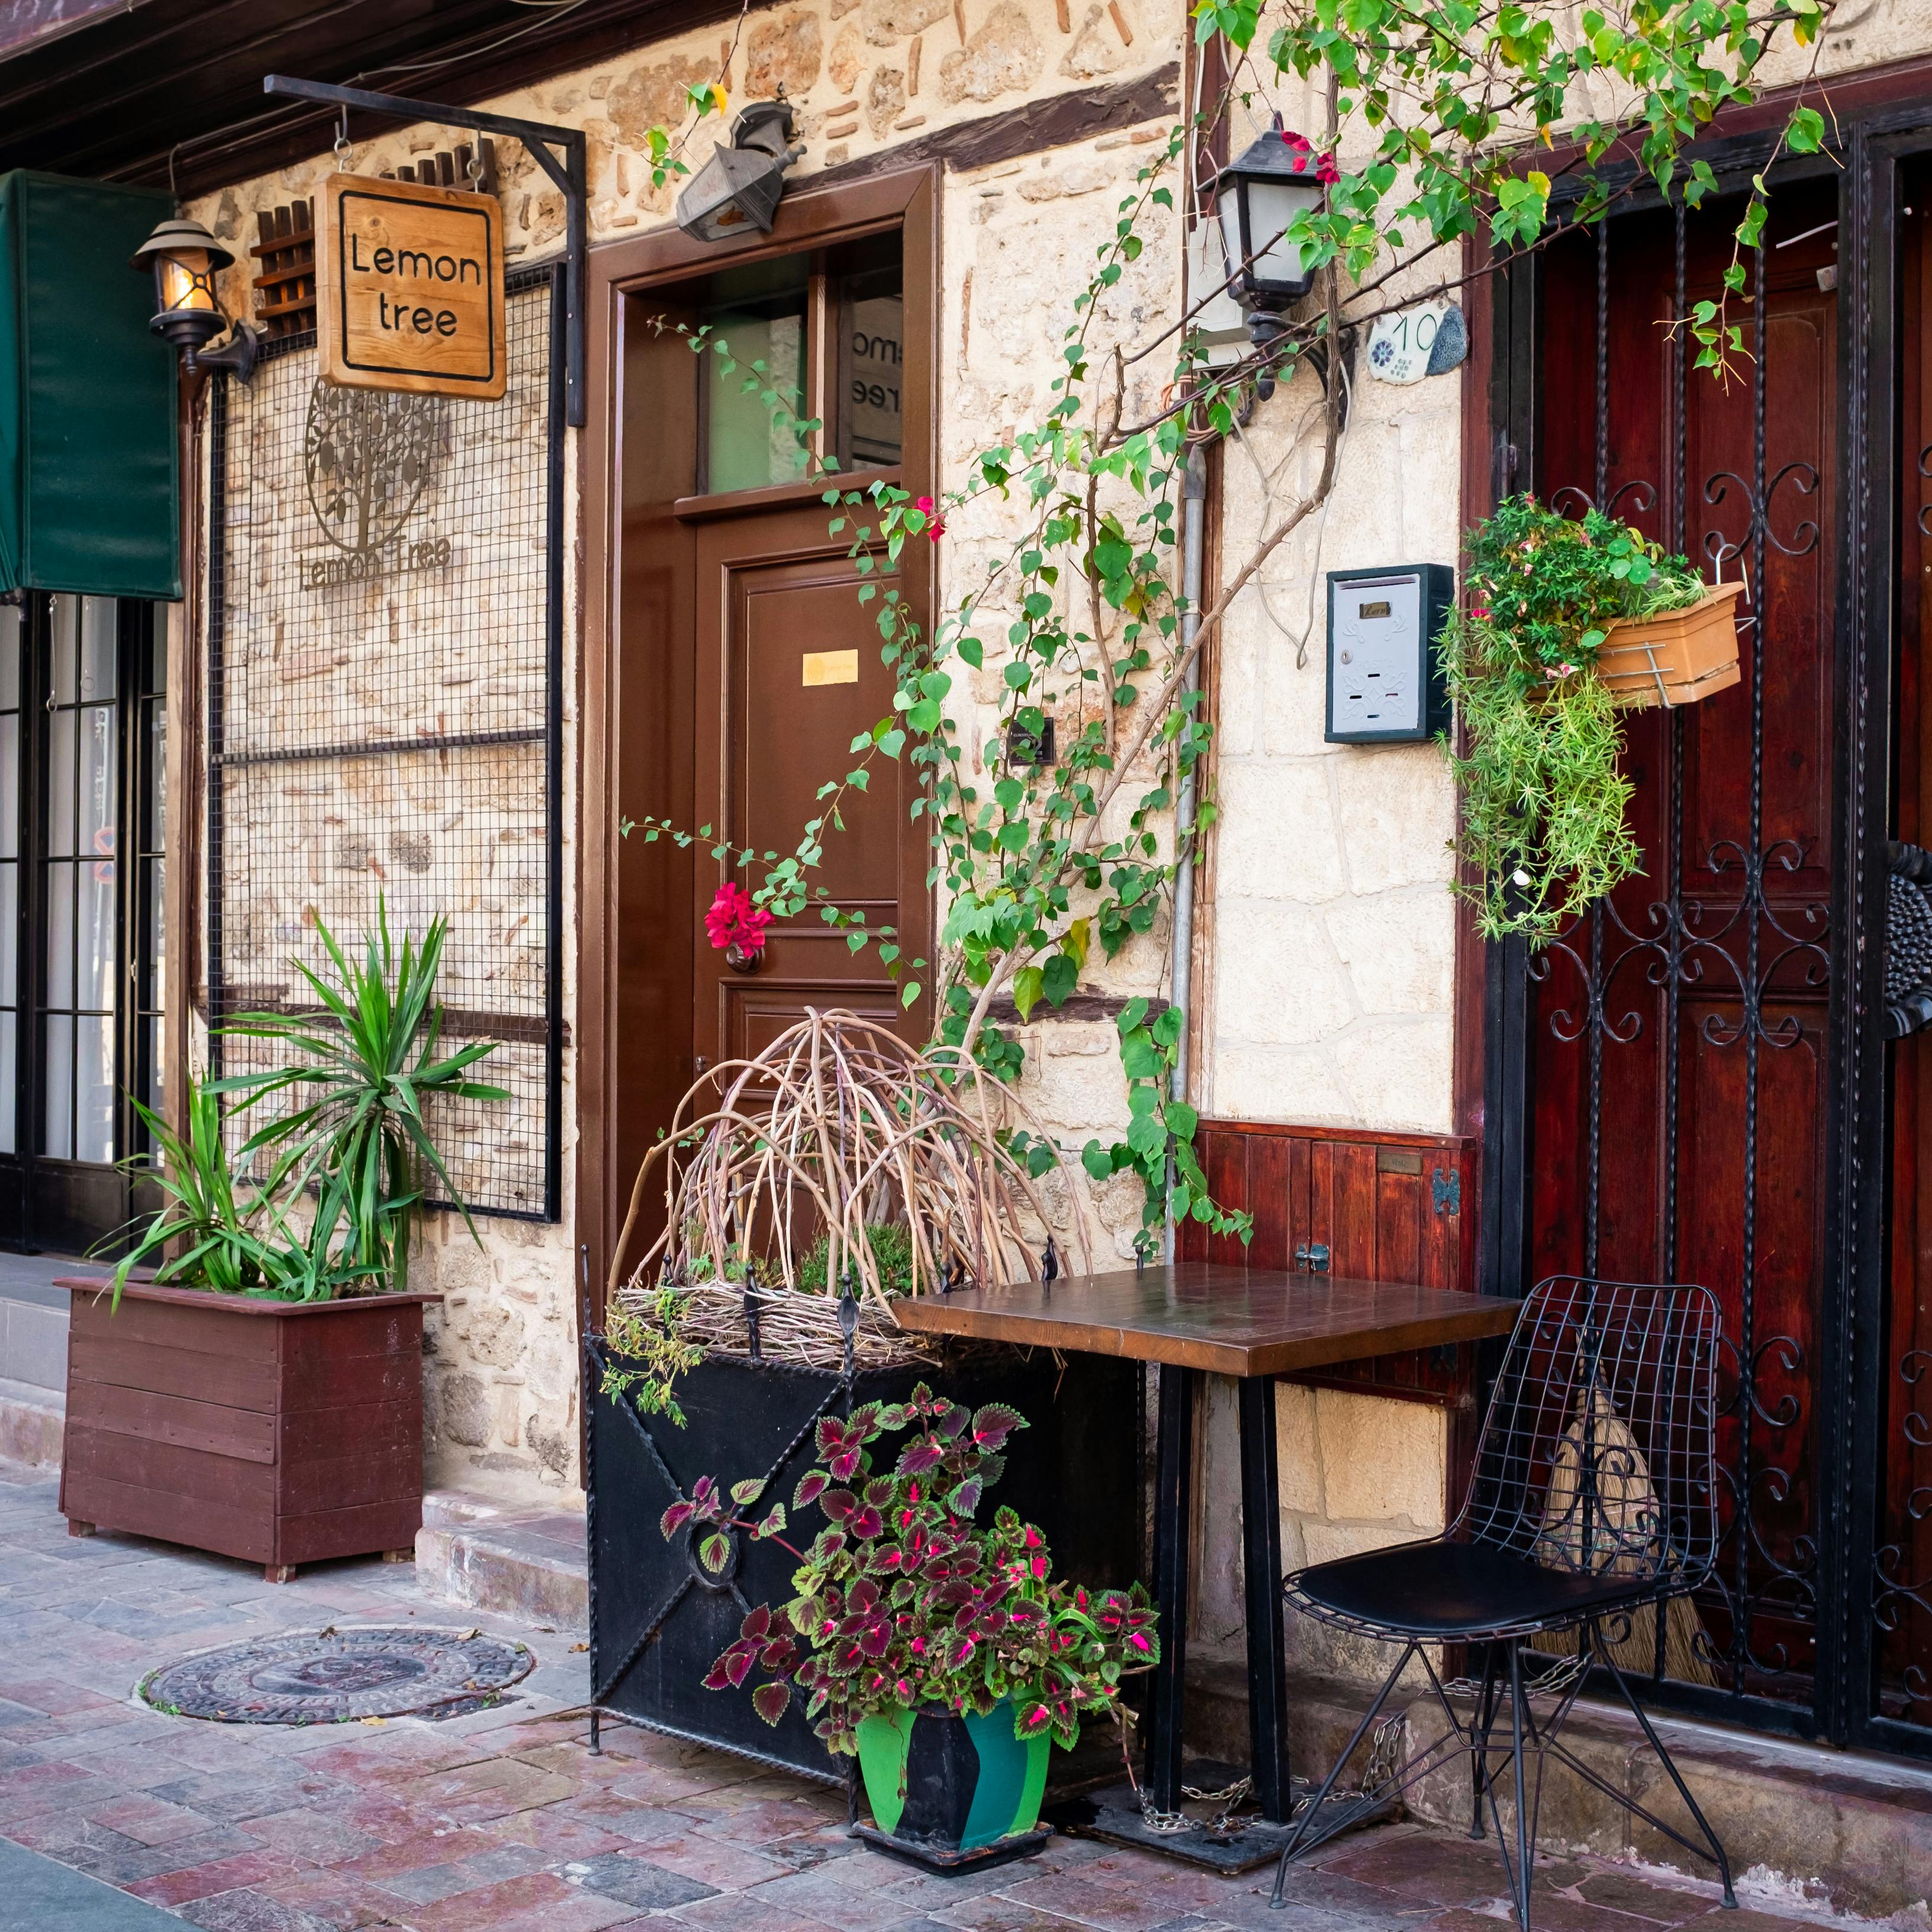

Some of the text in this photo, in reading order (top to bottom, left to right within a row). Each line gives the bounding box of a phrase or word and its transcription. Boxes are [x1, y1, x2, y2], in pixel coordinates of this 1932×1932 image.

[352, 233, 481, 286] Lemon
[380, 292, 458, 337] tree
[1393, 313, 1437, 352] 10
[389, 534, 452, 572] Tree
